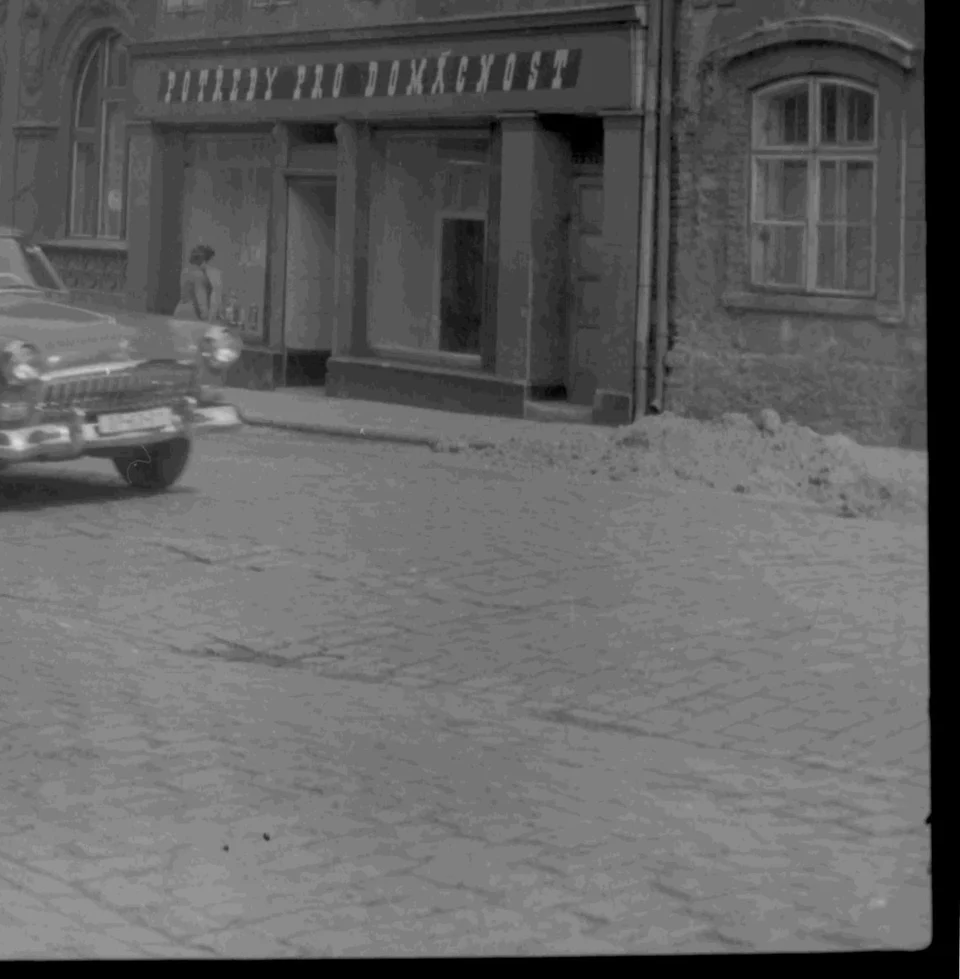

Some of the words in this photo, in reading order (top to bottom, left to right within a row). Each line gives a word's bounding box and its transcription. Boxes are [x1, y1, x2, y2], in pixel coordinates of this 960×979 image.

[165, 65, 278, 103] POTŘEBY
[292, 63, 344, 100] PRO
[365, 49, 569, 97] DOMÁCNOST
